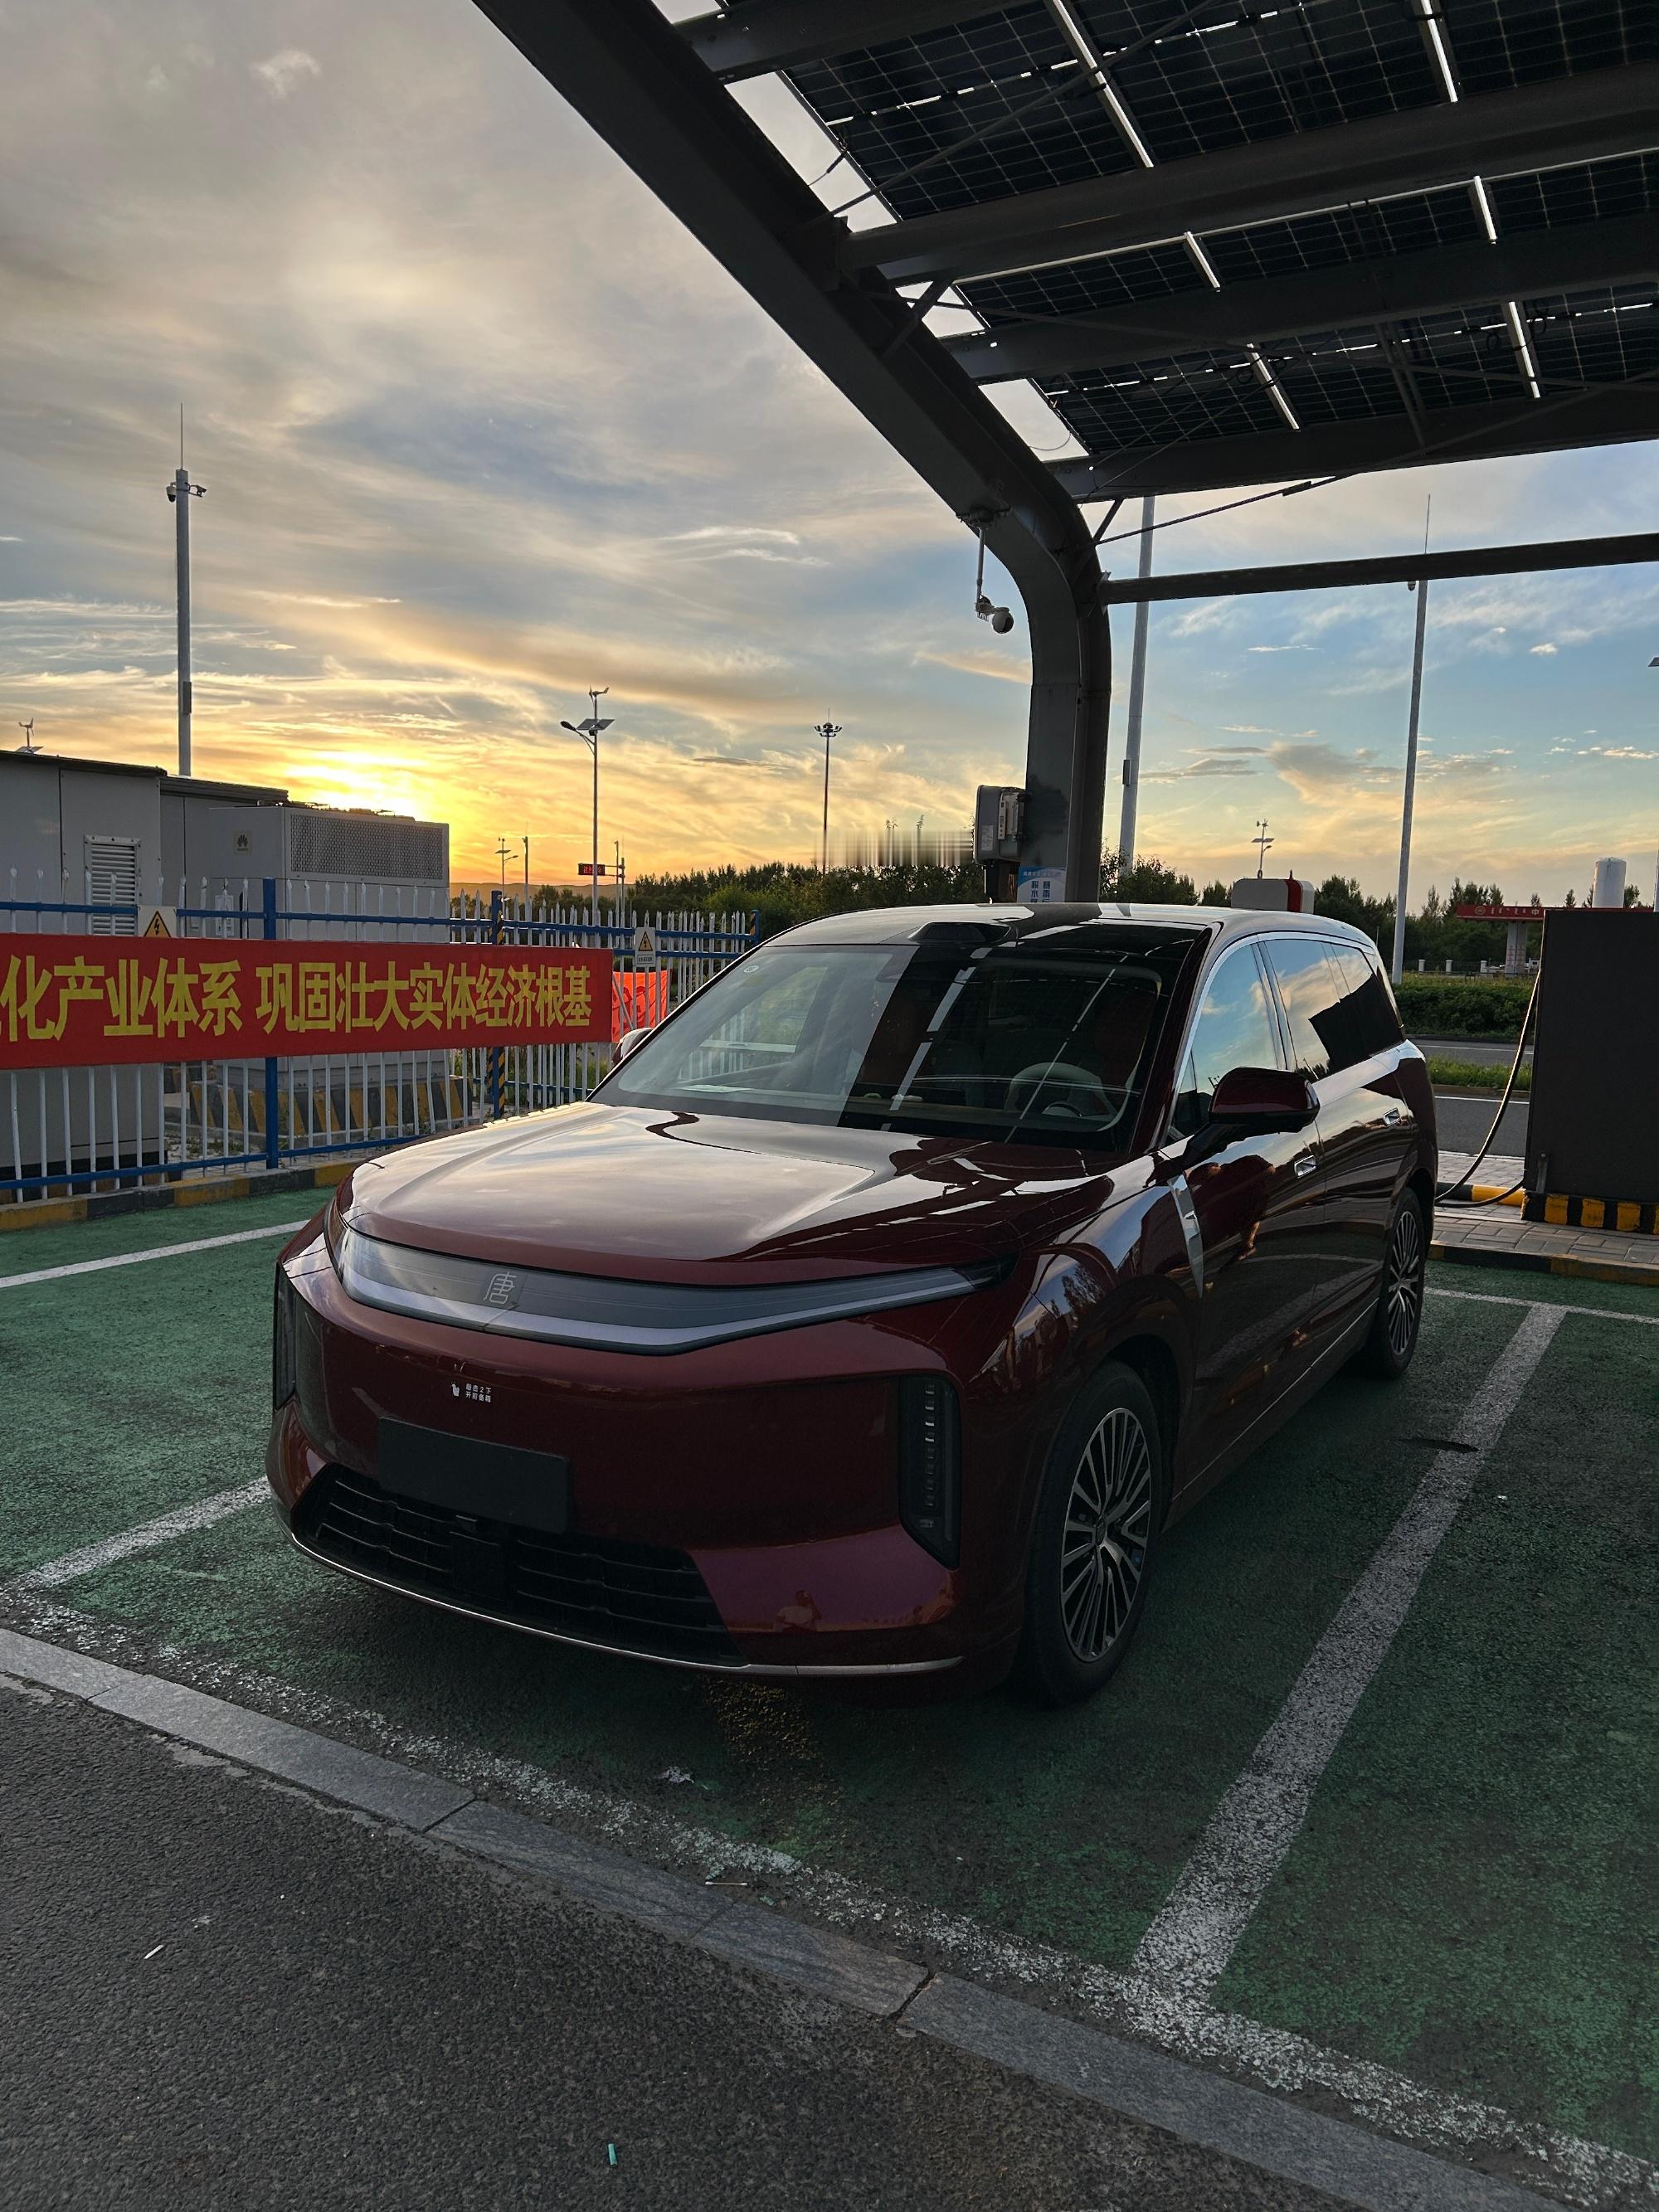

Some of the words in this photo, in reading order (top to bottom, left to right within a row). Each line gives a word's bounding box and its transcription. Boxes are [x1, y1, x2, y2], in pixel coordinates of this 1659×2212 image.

[0, 955, 243, 1043] 化产业体系
[255, 960, 591, 1034] 巩固壮大实体经济根基
